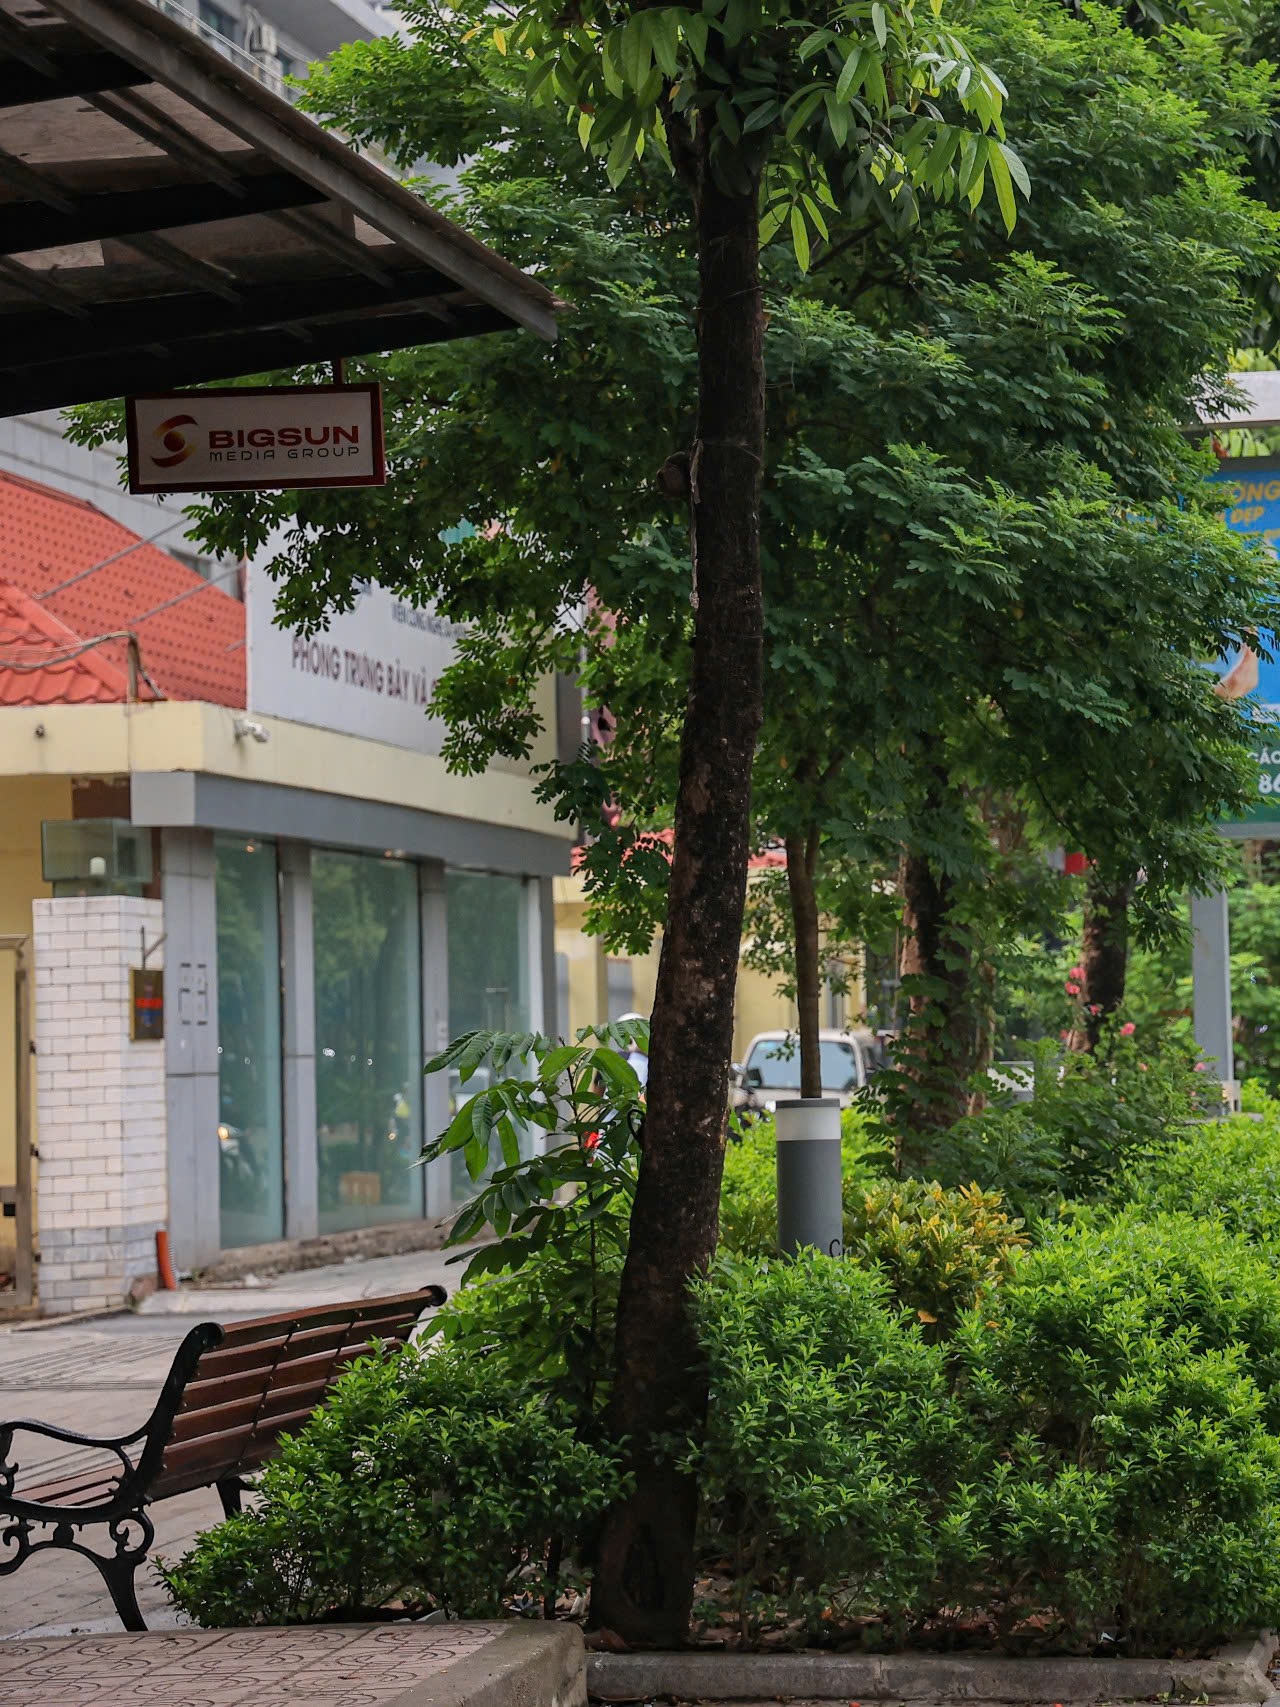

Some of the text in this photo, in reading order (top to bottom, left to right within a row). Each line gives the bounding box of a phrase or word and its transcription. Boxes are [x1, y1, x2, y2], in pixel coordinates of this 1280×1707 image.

[208, 425, 359, 449] BIGSUN
[210, 446, 360, 462] MEDIA GROUP
